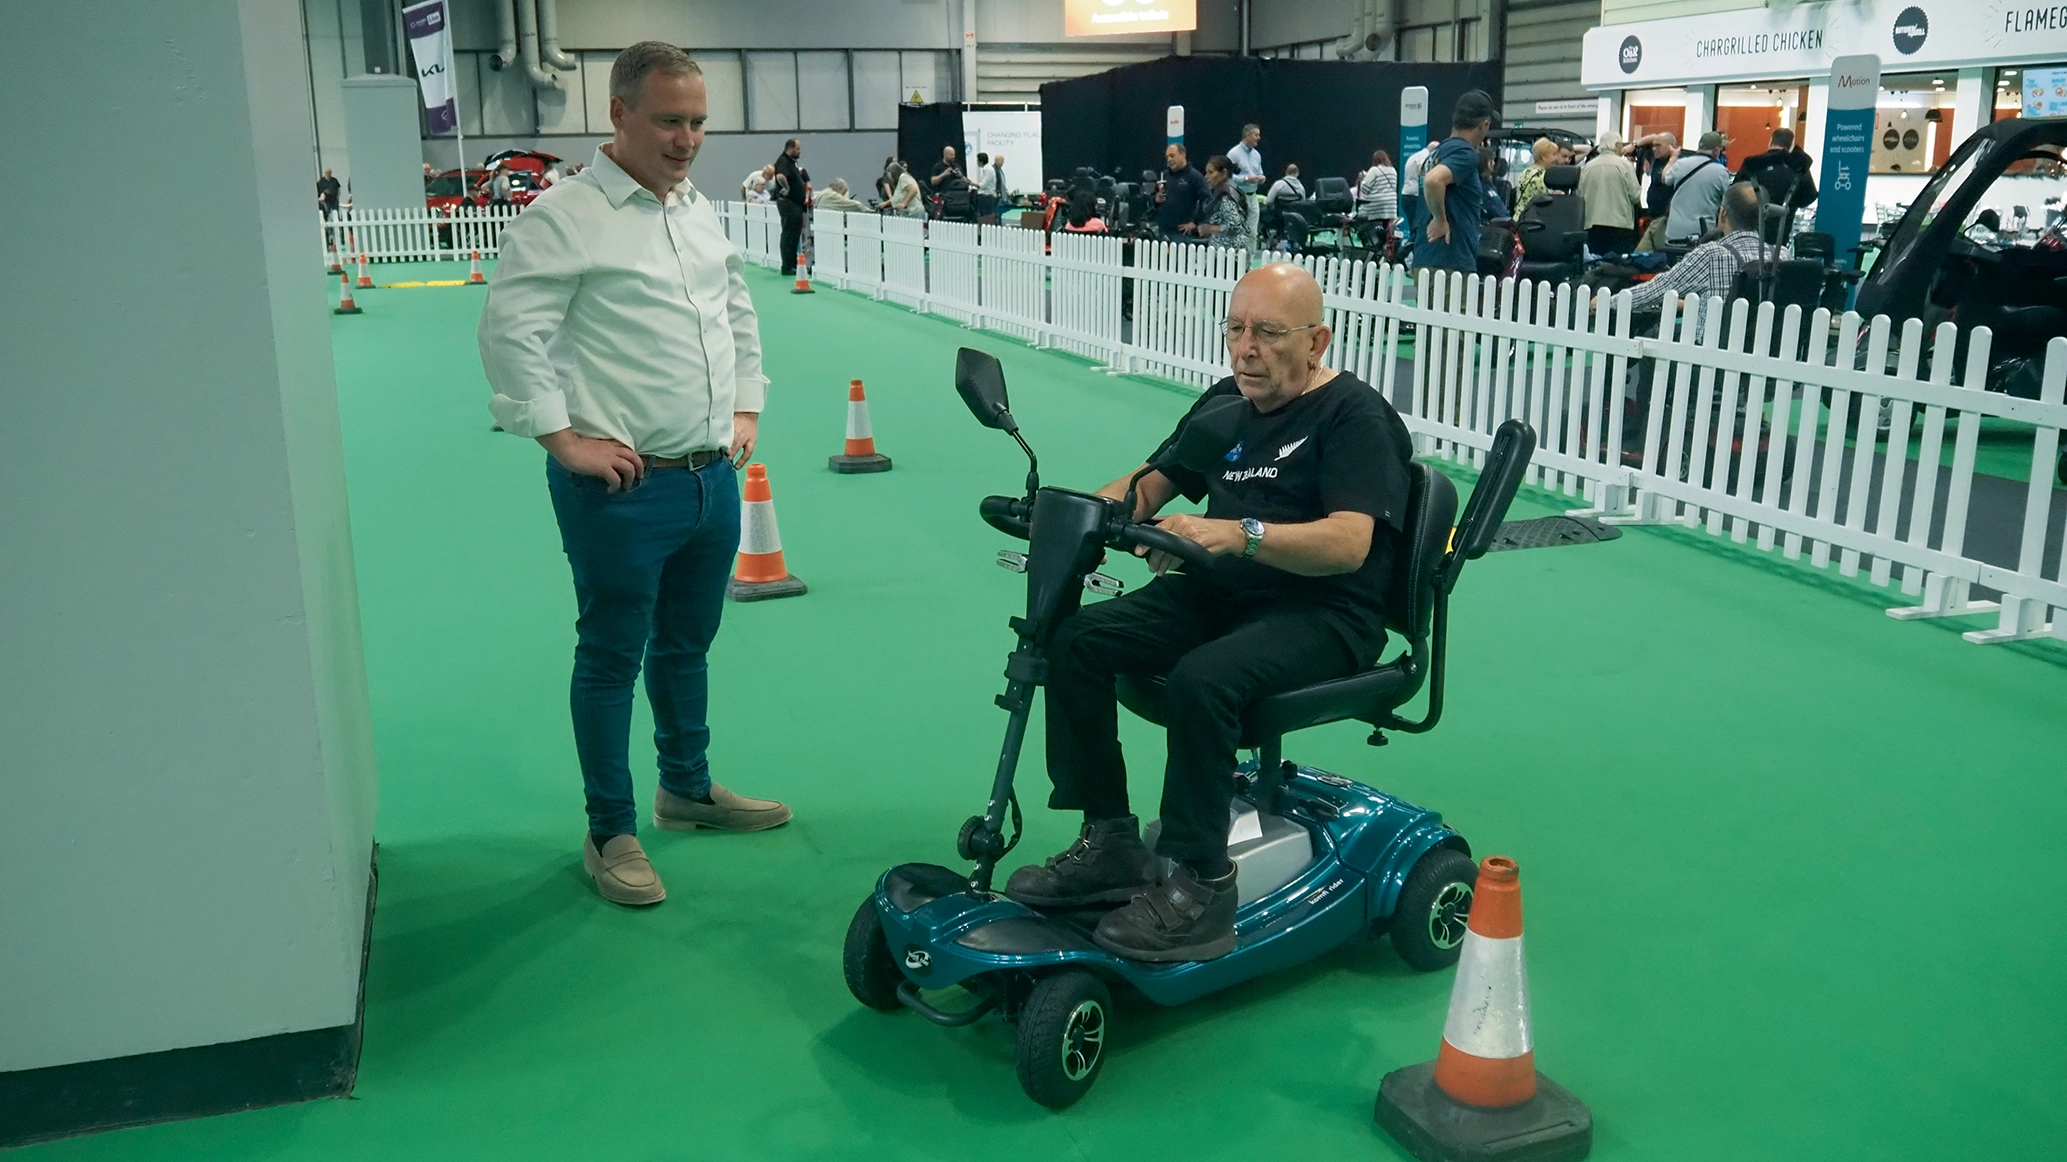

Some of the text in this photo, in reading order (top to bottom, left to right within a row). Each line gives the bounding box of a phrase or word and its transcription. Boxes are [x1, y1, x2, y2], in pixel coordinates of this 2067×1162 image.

[2005, 5, 2067, 33] FLAMEG
[1696, 29, 1824, 58] CHARGRILLED CHICKEN
[1838, 75, 1870, 88] Motion
[1222, 470, 1243, 482] NEW
